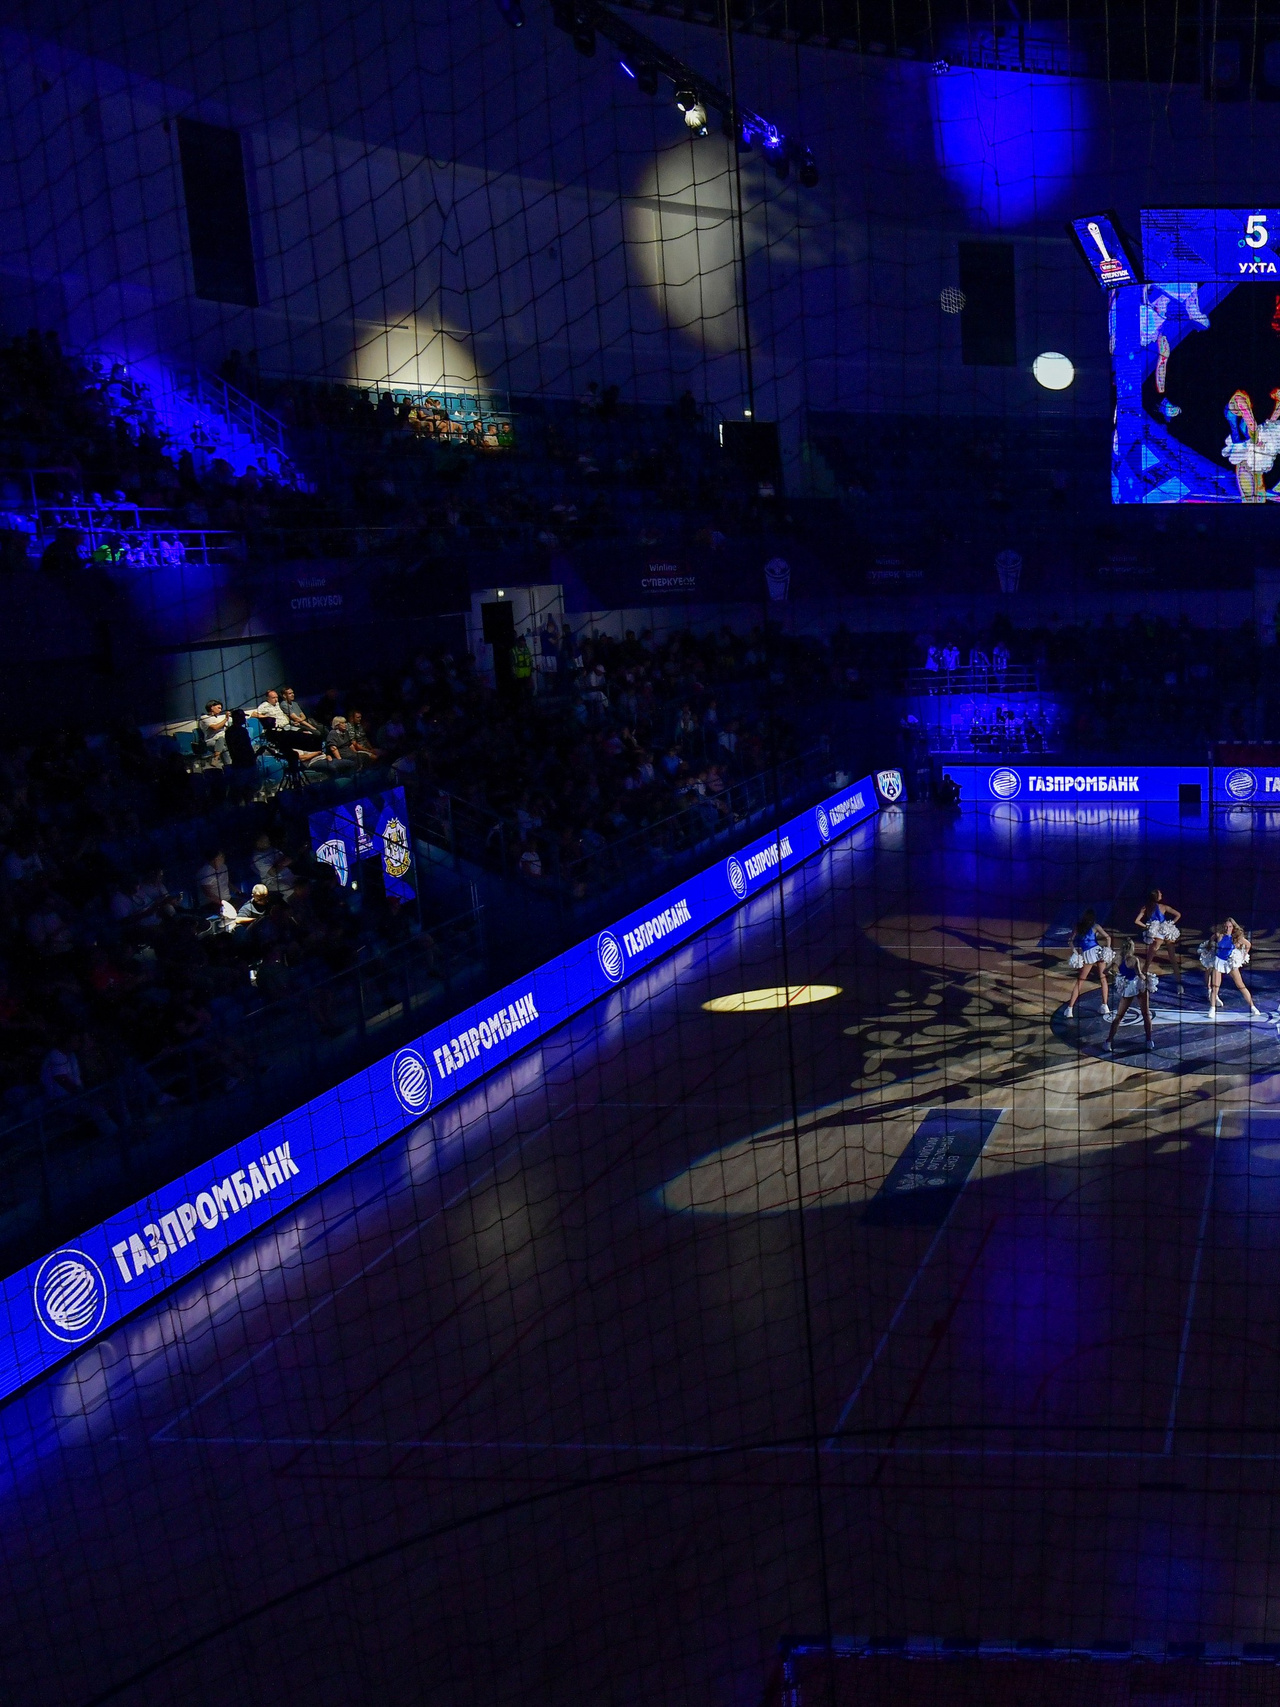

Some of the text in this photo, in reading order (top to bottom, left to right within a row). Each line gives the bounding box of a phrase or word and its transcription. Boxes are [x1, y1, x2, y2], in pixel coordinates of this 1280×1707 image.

[1245, 215, 1268, 248] 5
[1238, 262, 1277, 273] УХТА
[649, 563, 677, 572] Winline
[641, 577, 695, 587] СУПЕРКУБОК
[1028, 776, 1139, 792] ГАЗПРОМБАНК
[623, 898, 691, 958] ГАЗПРОМБАНК
[433, 992, 539, 1079] ГАЗПРОМБАНК
[112, 1141, 300, 1284] ГАЗПРОМБАНК
